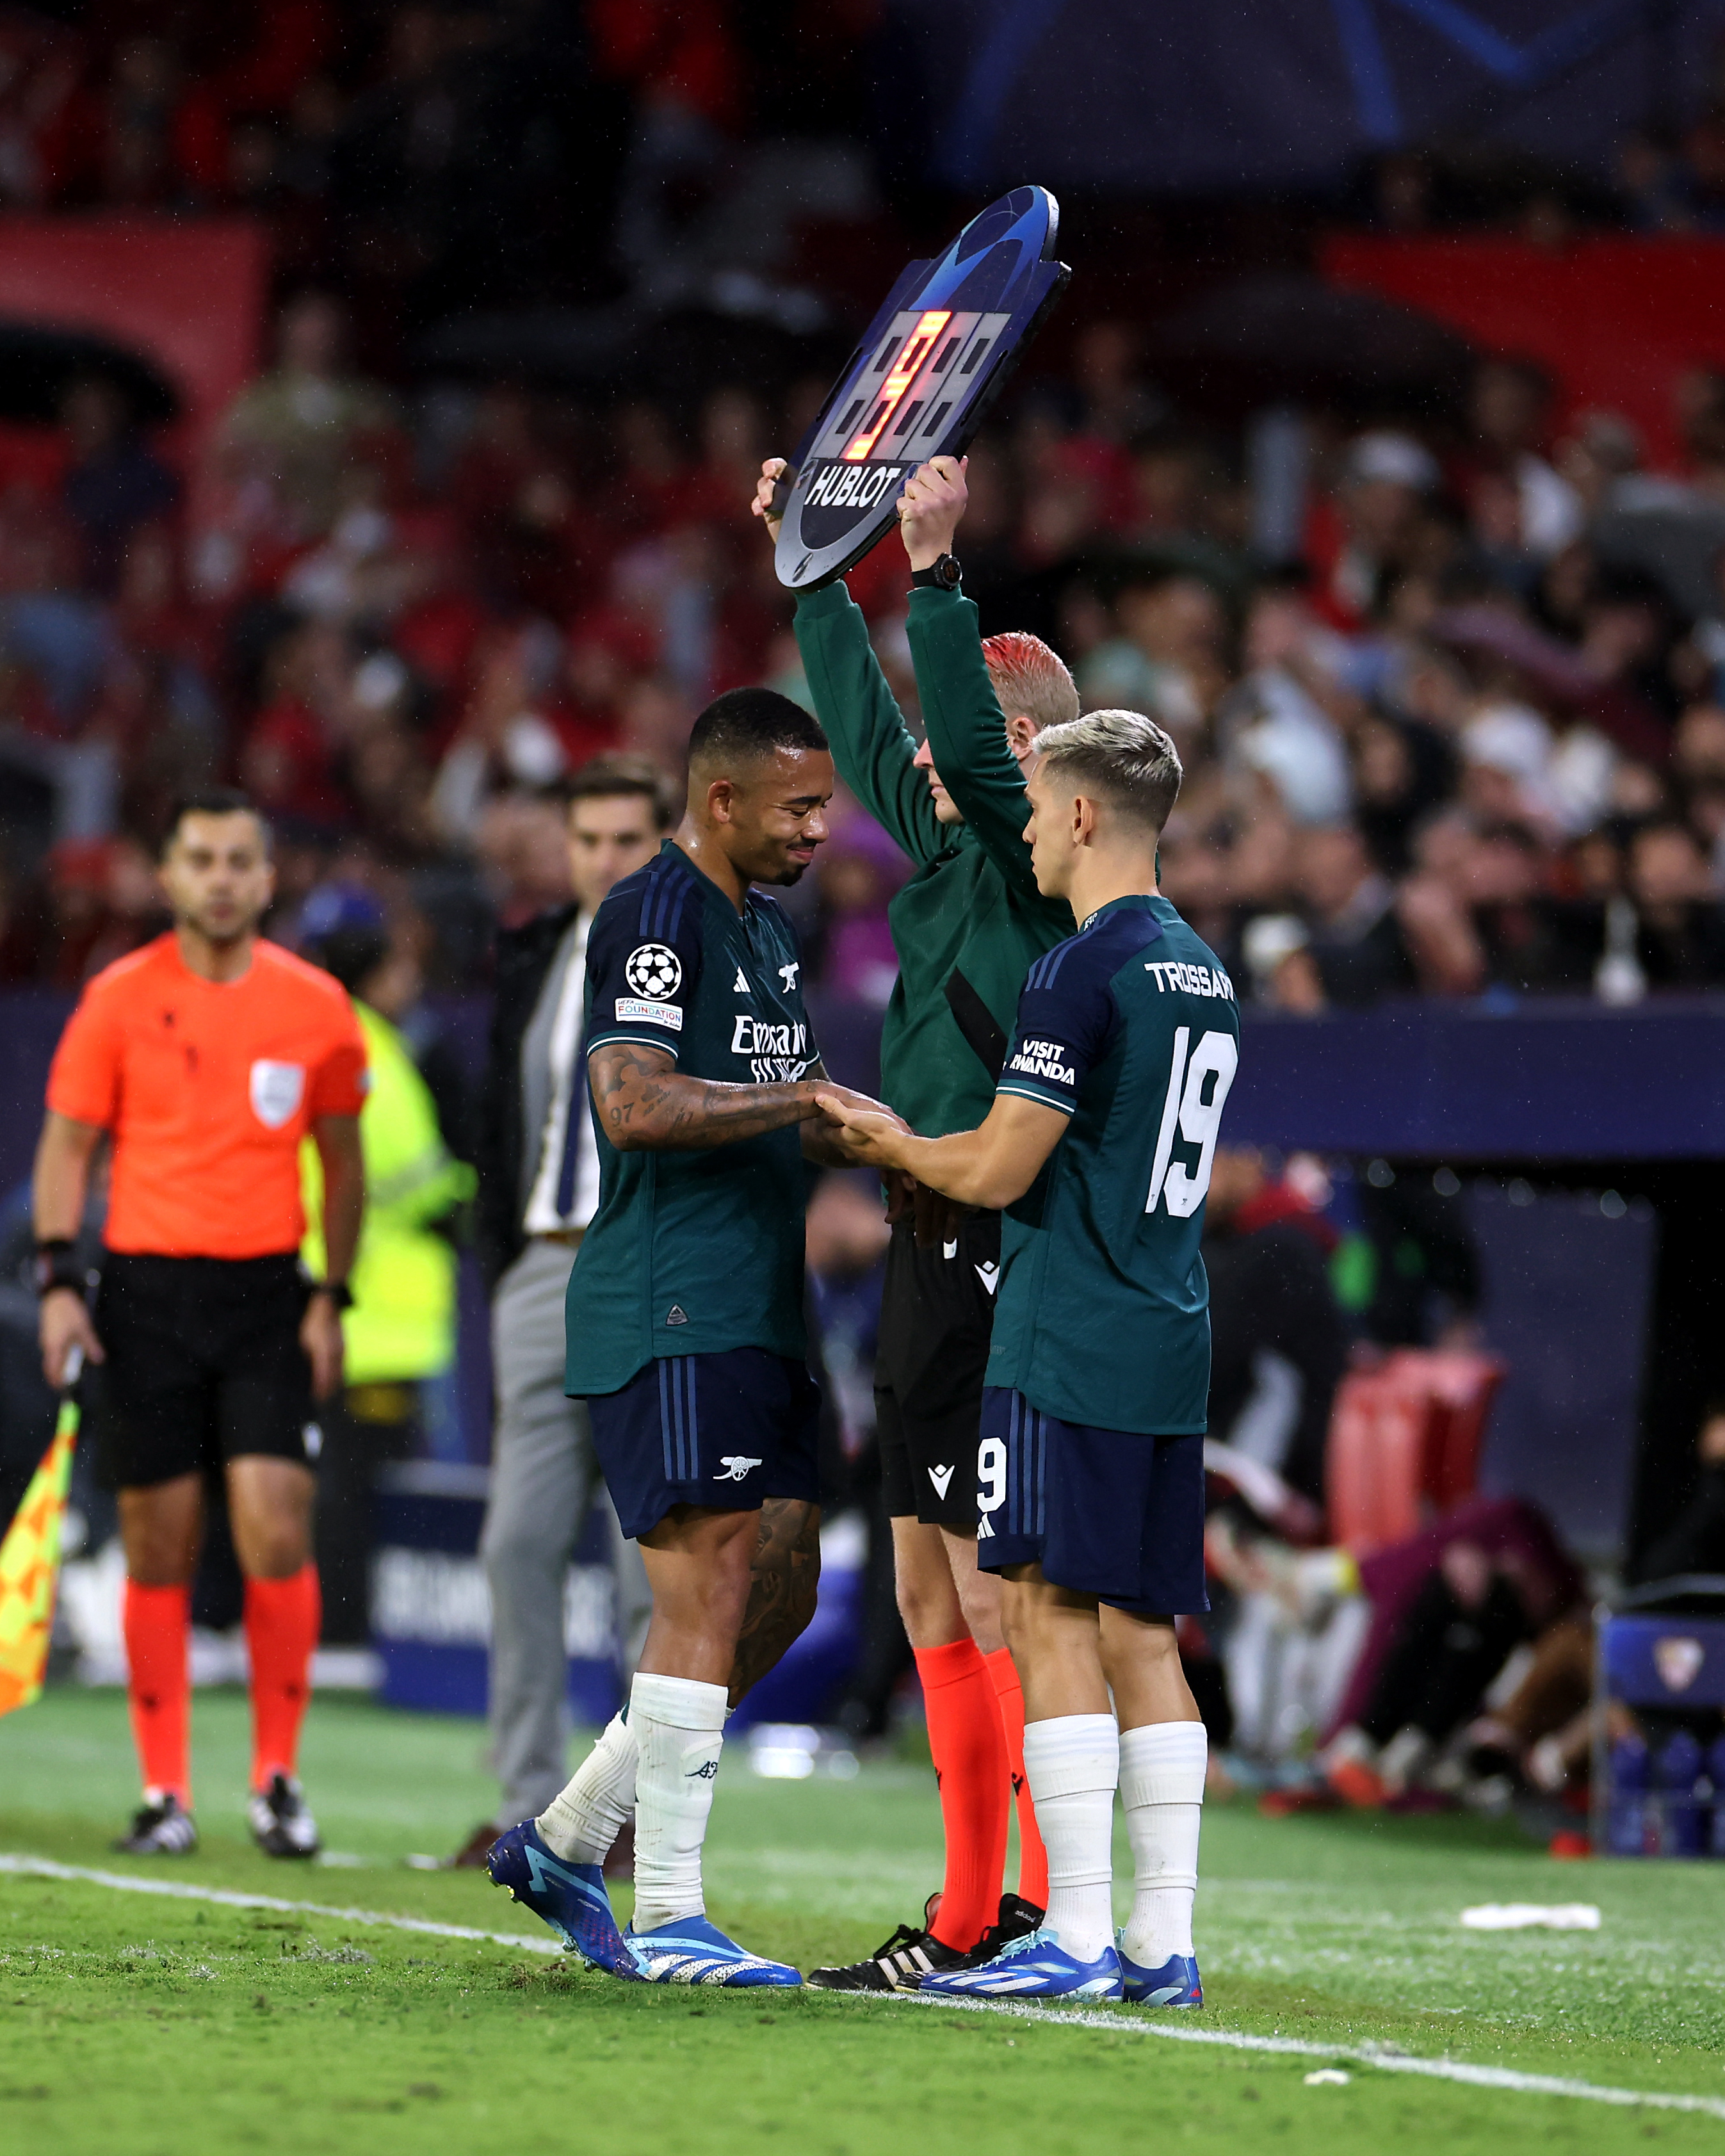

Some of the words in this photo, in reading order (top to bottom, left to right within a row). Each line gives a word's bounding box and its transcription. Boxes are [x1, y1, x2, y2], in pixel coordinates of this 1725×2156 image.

[844, 310, 953, 460] 9
[804, 465, 902, 508] HUBLOT
[618, 1005, 681, 1023] FOUNDATION
[1009, 1053, 1075, 1085] RWANDA
[1023, 1039, 1065, 1062] VISIT
[610, 1101, 635, 1127] 97
[1144, 1026, 1239, 1218] 19
[976, 1436, 1007, 1514] 9
